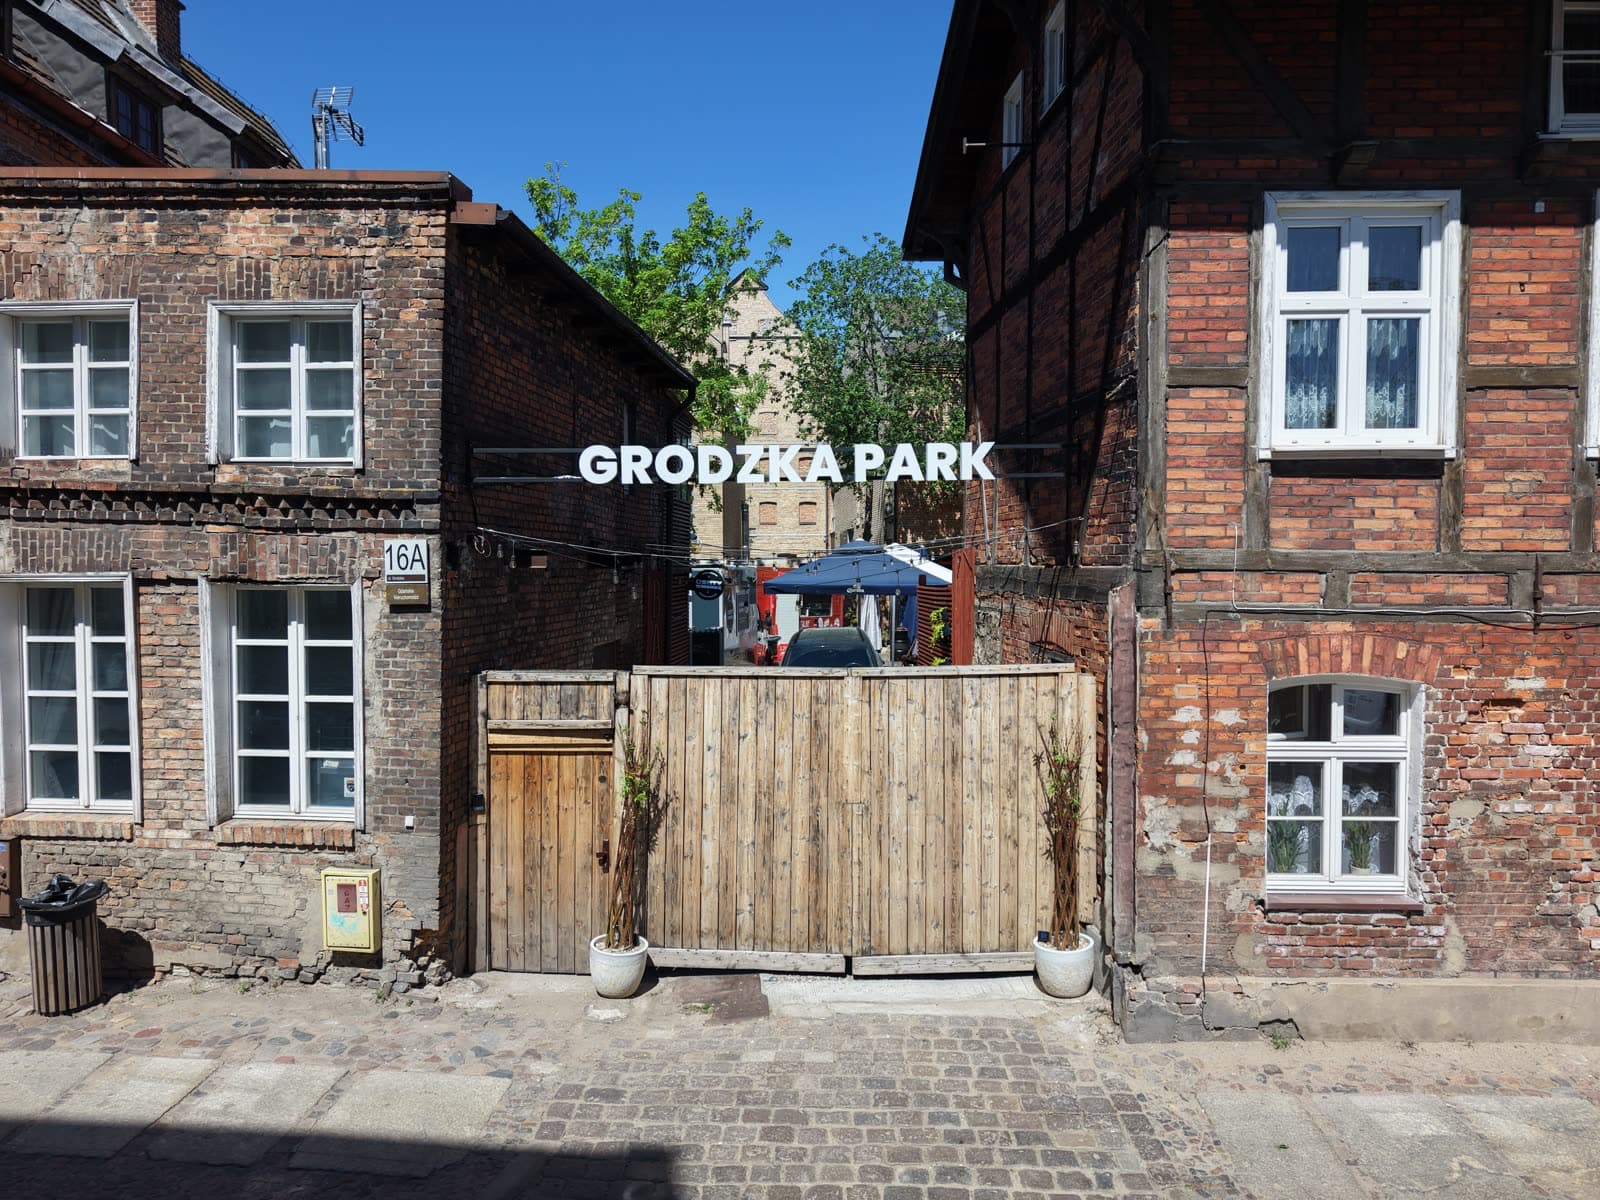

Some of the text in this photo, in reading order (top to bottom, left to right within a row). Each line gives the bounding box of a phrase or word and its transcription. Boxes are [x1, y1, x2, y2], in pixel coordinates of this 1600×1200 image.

[578, 441, 996, 485] GRODZKA PARK
[385, 544, 425, 570] 16A
